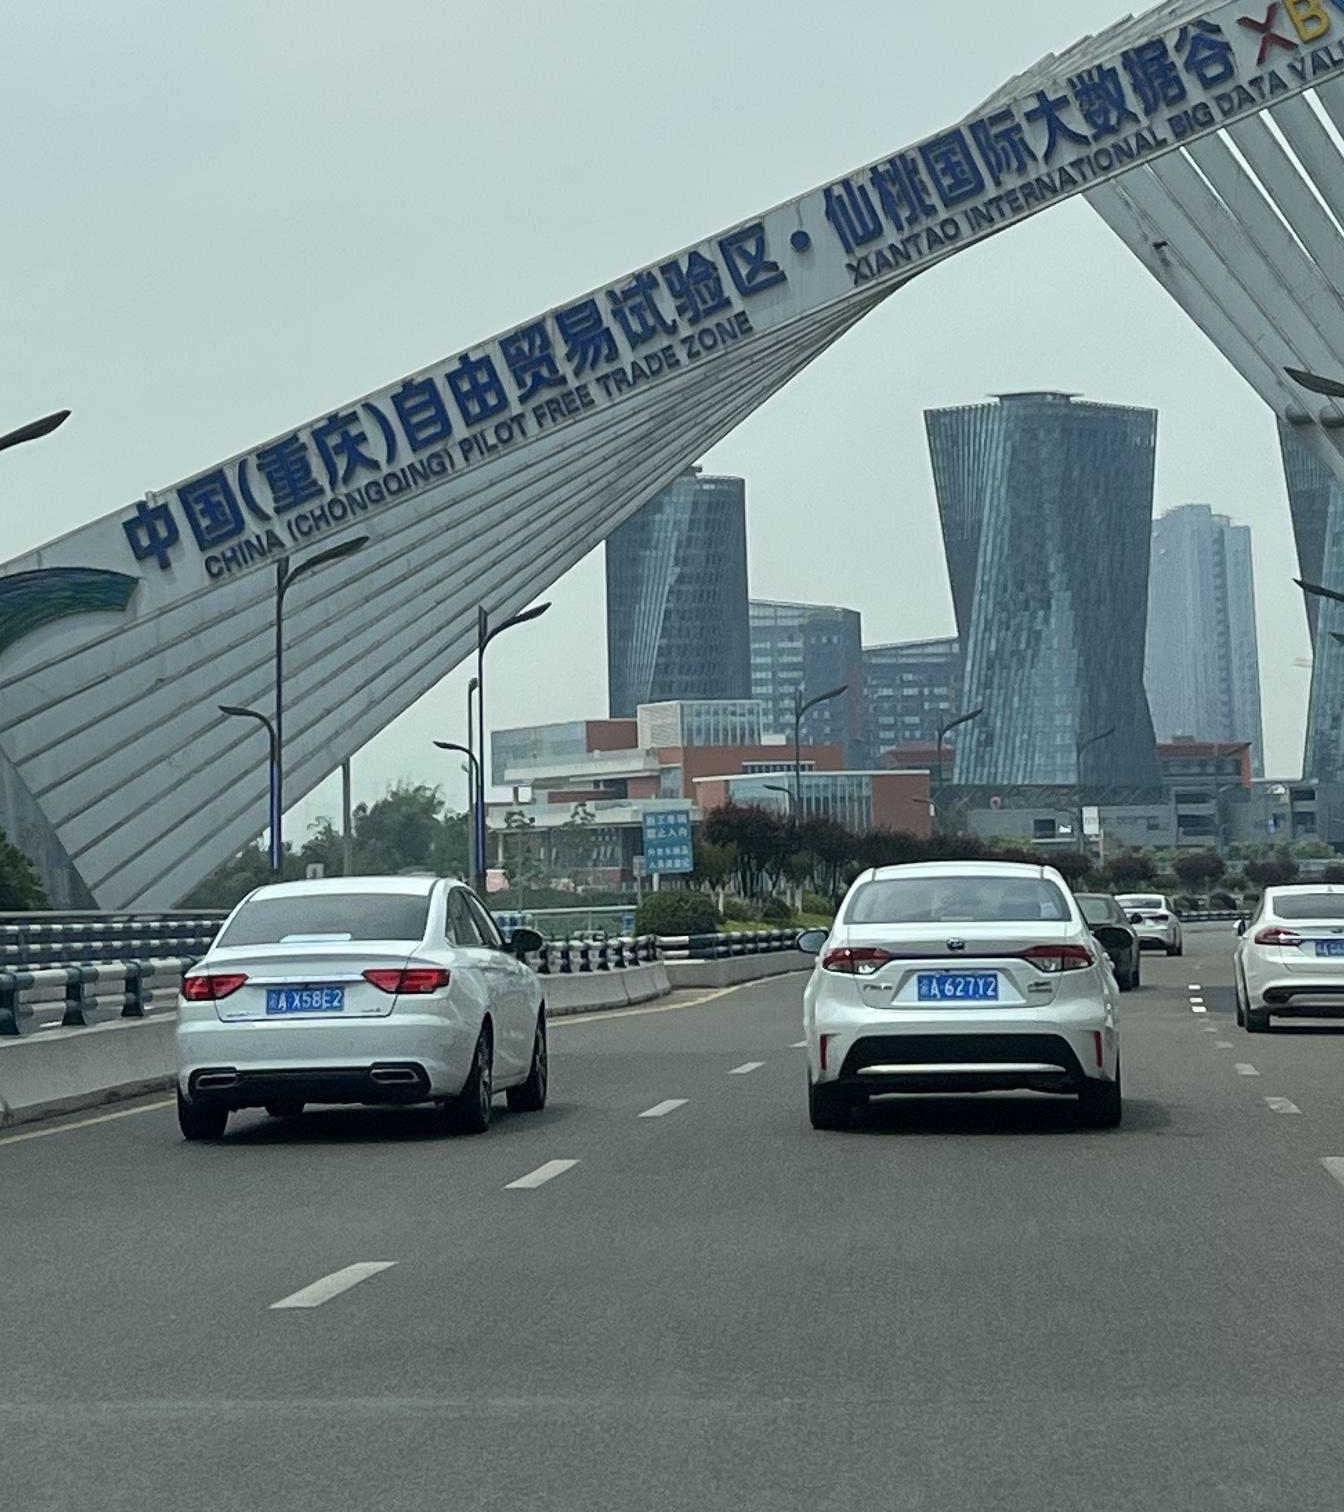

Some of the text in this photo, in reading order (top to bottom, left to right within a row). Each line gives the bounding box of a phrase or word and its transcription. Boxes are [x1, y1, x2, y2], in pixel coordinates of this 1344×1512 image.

[845, 217, 961, 286] XIANTAO
[965, 126, 1167, 233] INTERNATIONAL
[1167, 101, 1216, 139] BIG
[1214, 69, 1289, 117] DATA
[205, 310, 755, 579] CHINA (CHONGQING) PILOT FREE TRADE ZONE
